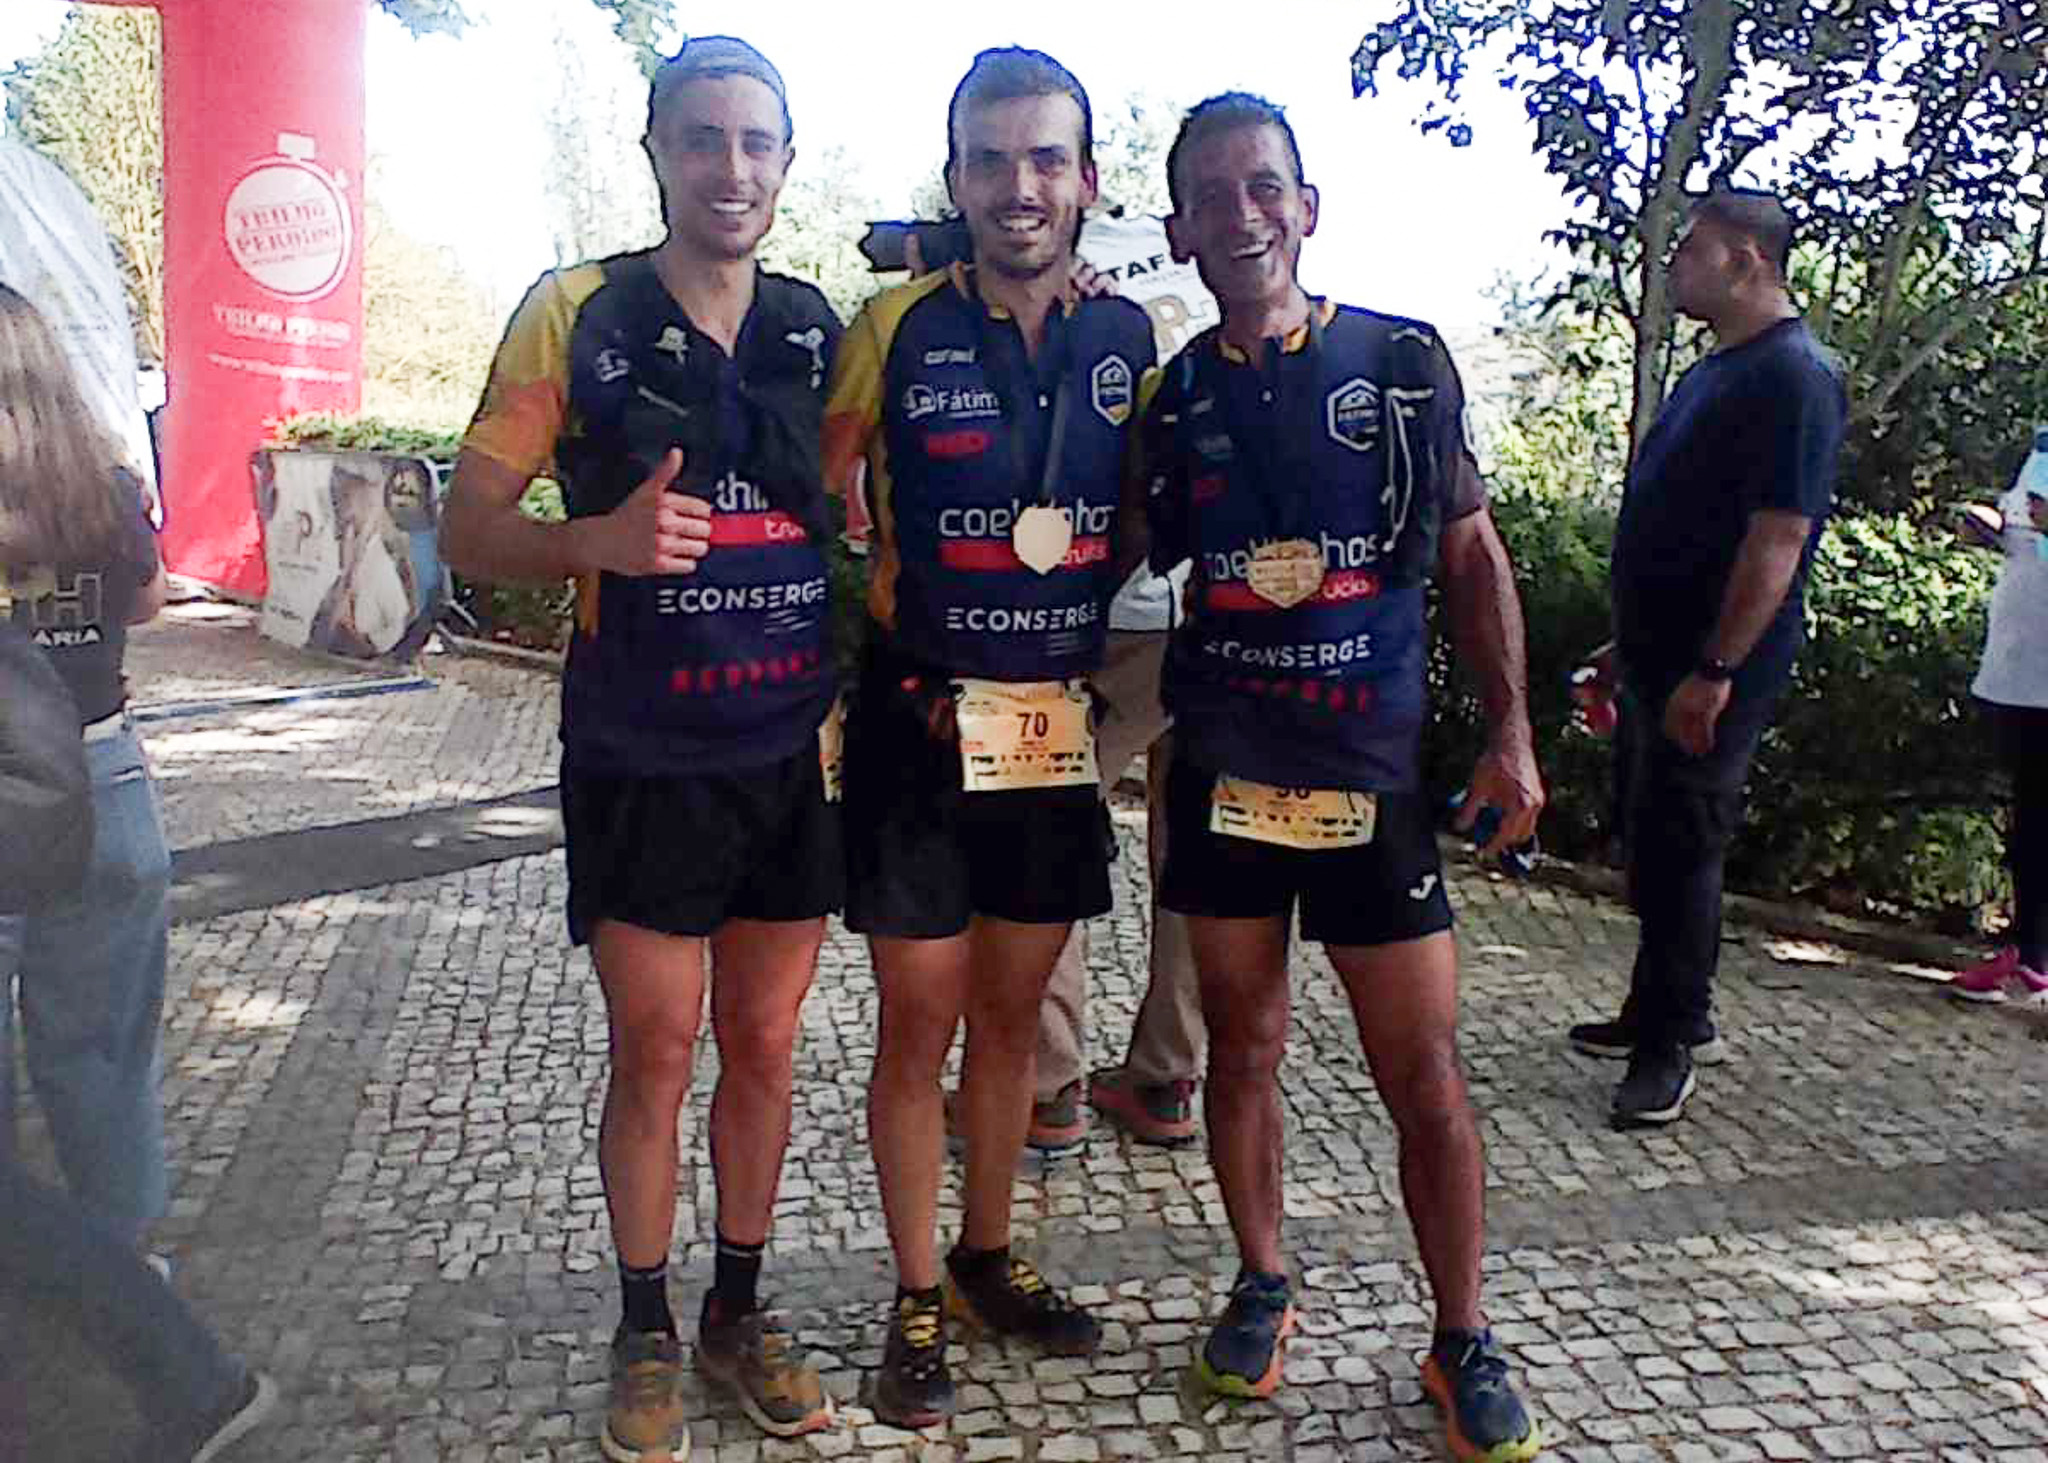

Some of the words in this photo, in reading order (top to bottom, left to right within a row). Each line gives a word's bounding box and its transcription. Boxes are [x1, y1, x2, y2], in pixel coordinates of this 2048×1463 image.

[656, 577, 827, 613] ECONSERGE
[945, 602, 1098, 632] ECONSERGE
[1017, 711, 1048, 738] 70
